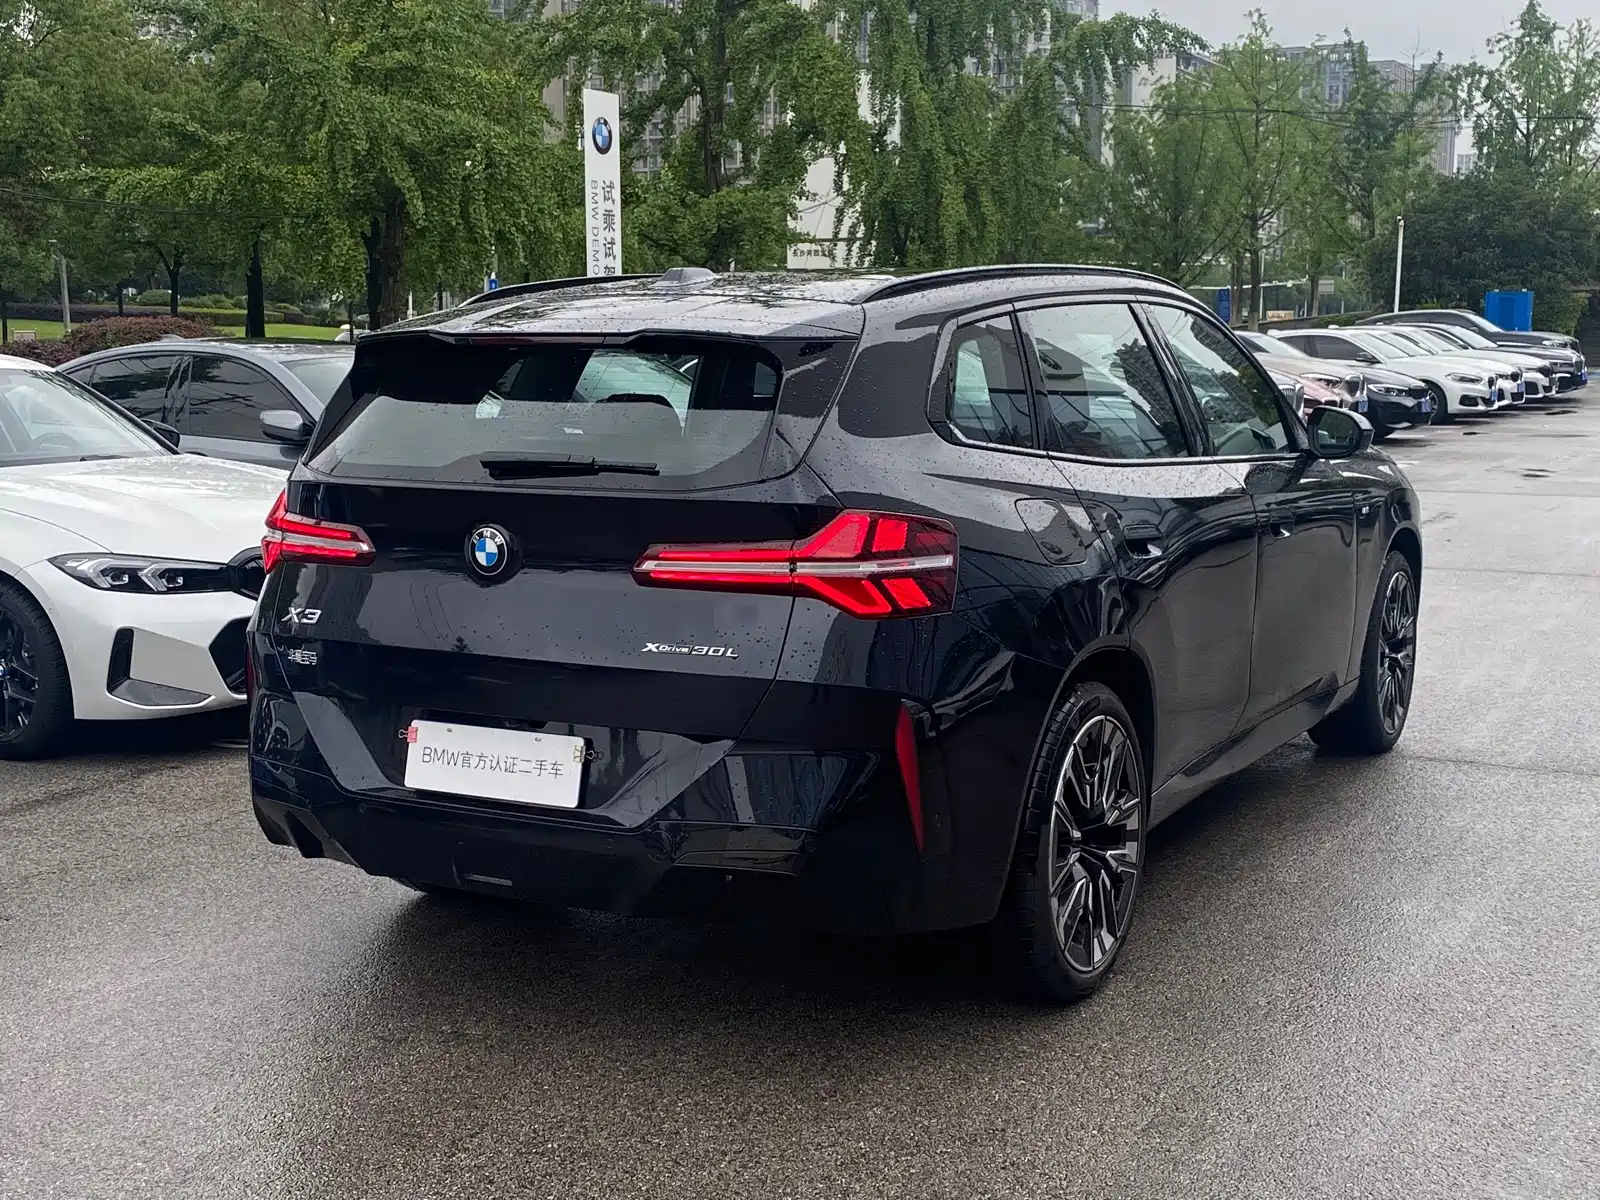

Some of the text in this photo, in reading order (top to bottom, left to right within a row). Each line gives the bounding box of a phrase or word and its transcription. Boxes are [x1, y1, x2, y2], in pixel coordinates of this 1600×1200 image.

[591, 180, 600, 275] BMW DEMO
[281, 607, 321, 624] X3
[421, 746, 564, 779] BMW官方认证二手车
